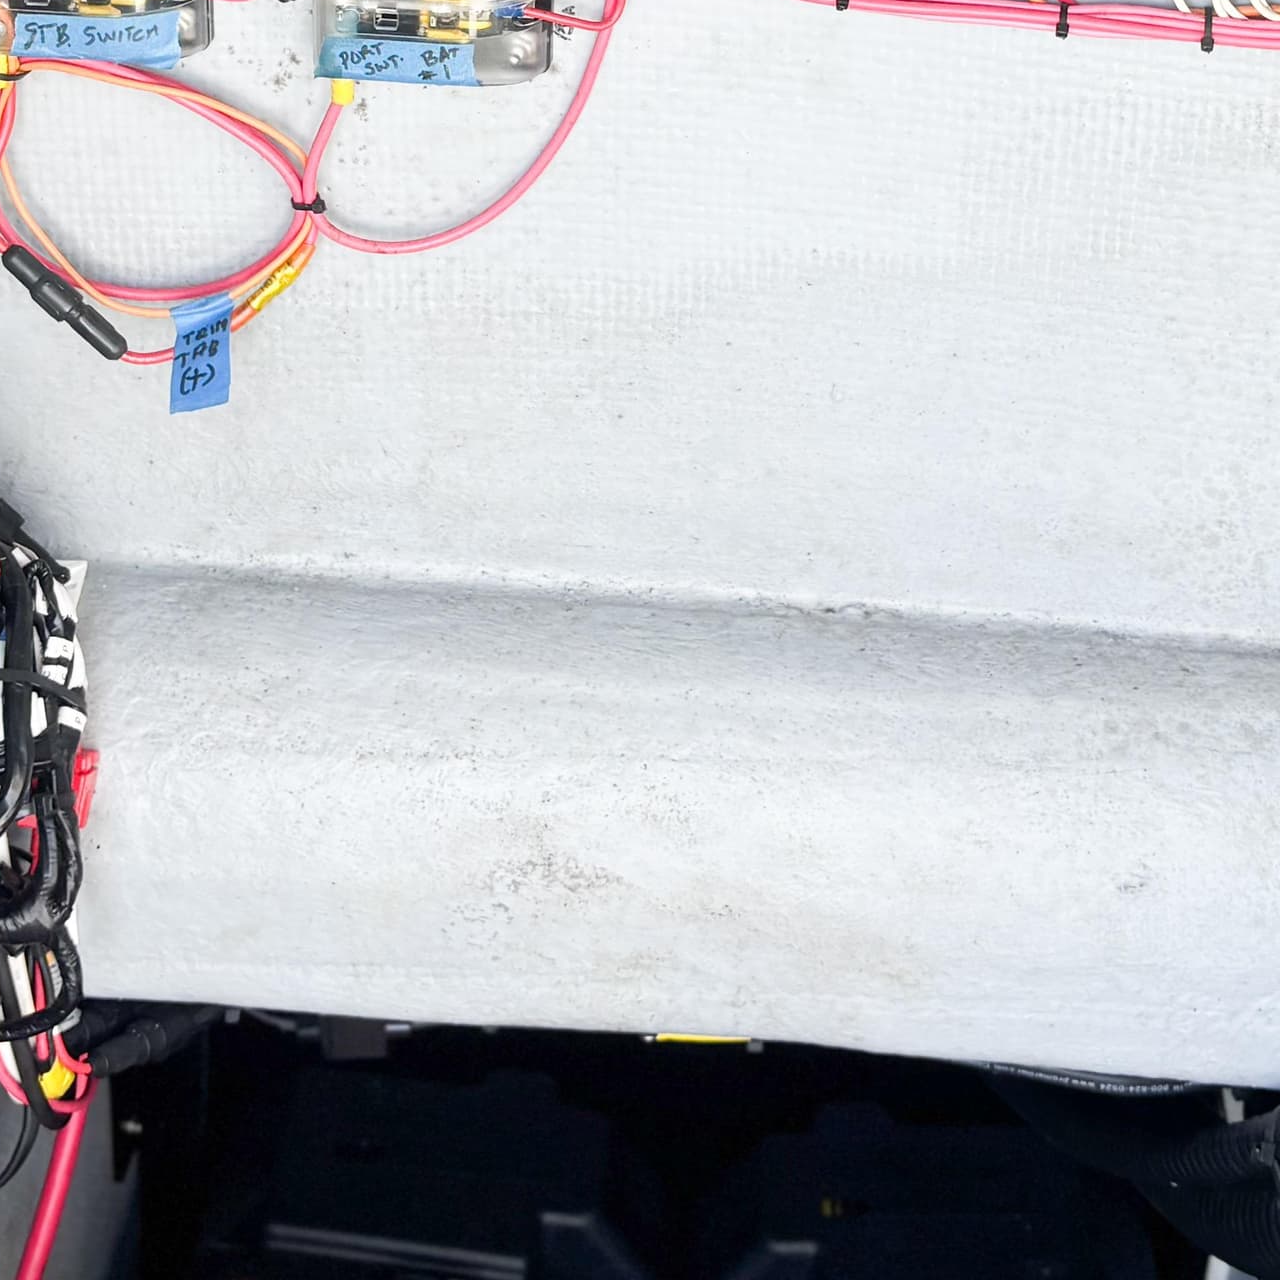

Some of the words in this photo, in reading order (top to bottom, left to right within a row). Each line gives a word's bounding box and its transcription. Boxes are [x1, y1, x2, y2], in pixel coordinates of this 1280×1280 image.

[82, 24, 160, 47] SWITCH
[338, 41, 384, 71] PORT
[420, 45, 461, 68] BAT
[173, 338, 220, 369] TAB
